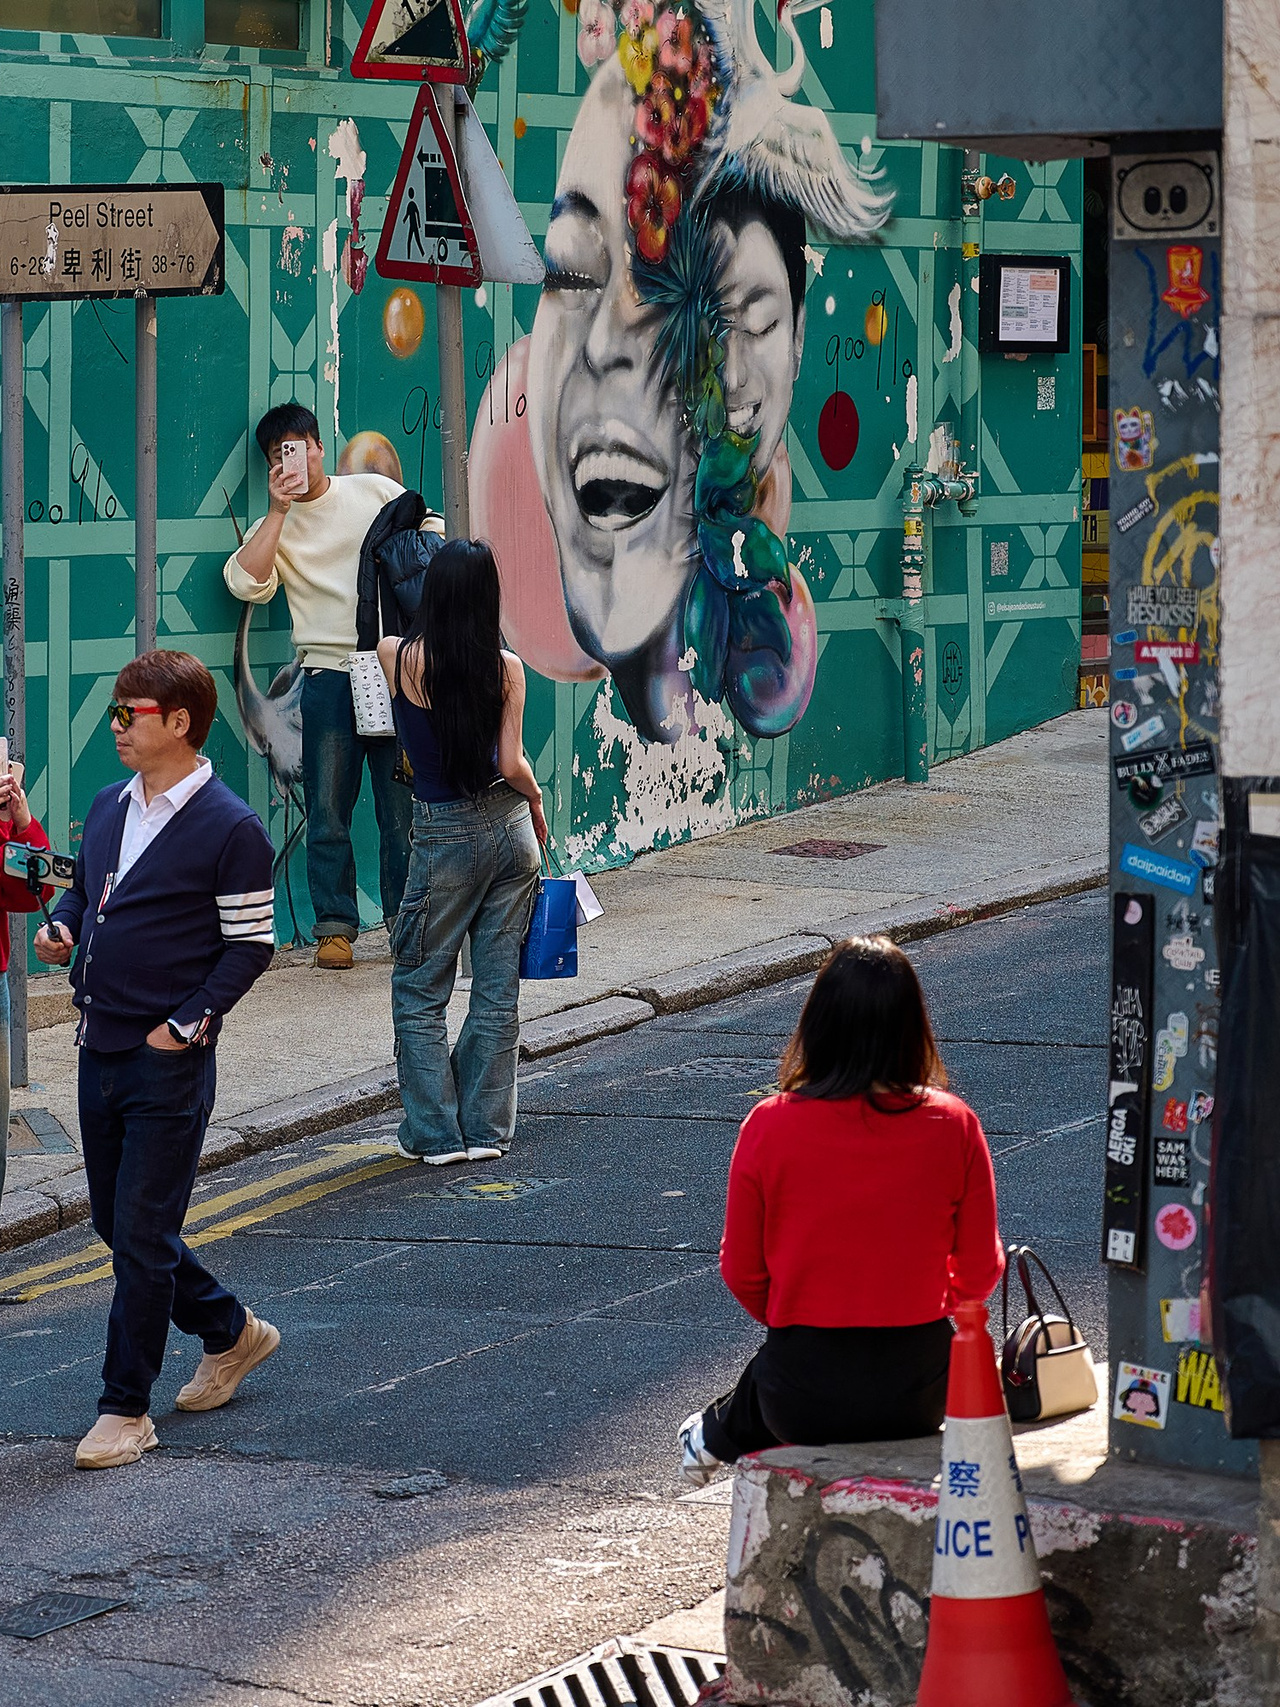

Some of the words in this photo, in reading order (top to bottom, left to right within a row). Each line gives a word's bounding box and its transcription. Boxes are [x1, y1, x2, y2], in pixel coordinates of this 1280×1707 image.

[49, 201, 90, 228] Peel
[96, 202, 154, 228] Street
[61, 247, 142, 283] 卑利街
[1116, 760, 1156, 779] BULLY
[1170, 750, 1210, 769] FADES
[1156, 1153, 1186, 1167] WAS
[1157, 1140, 1186, 1154] SAM
[1155, 1166, 1188, 1179] HERE
[948, 1459, 981, 1498] 察
